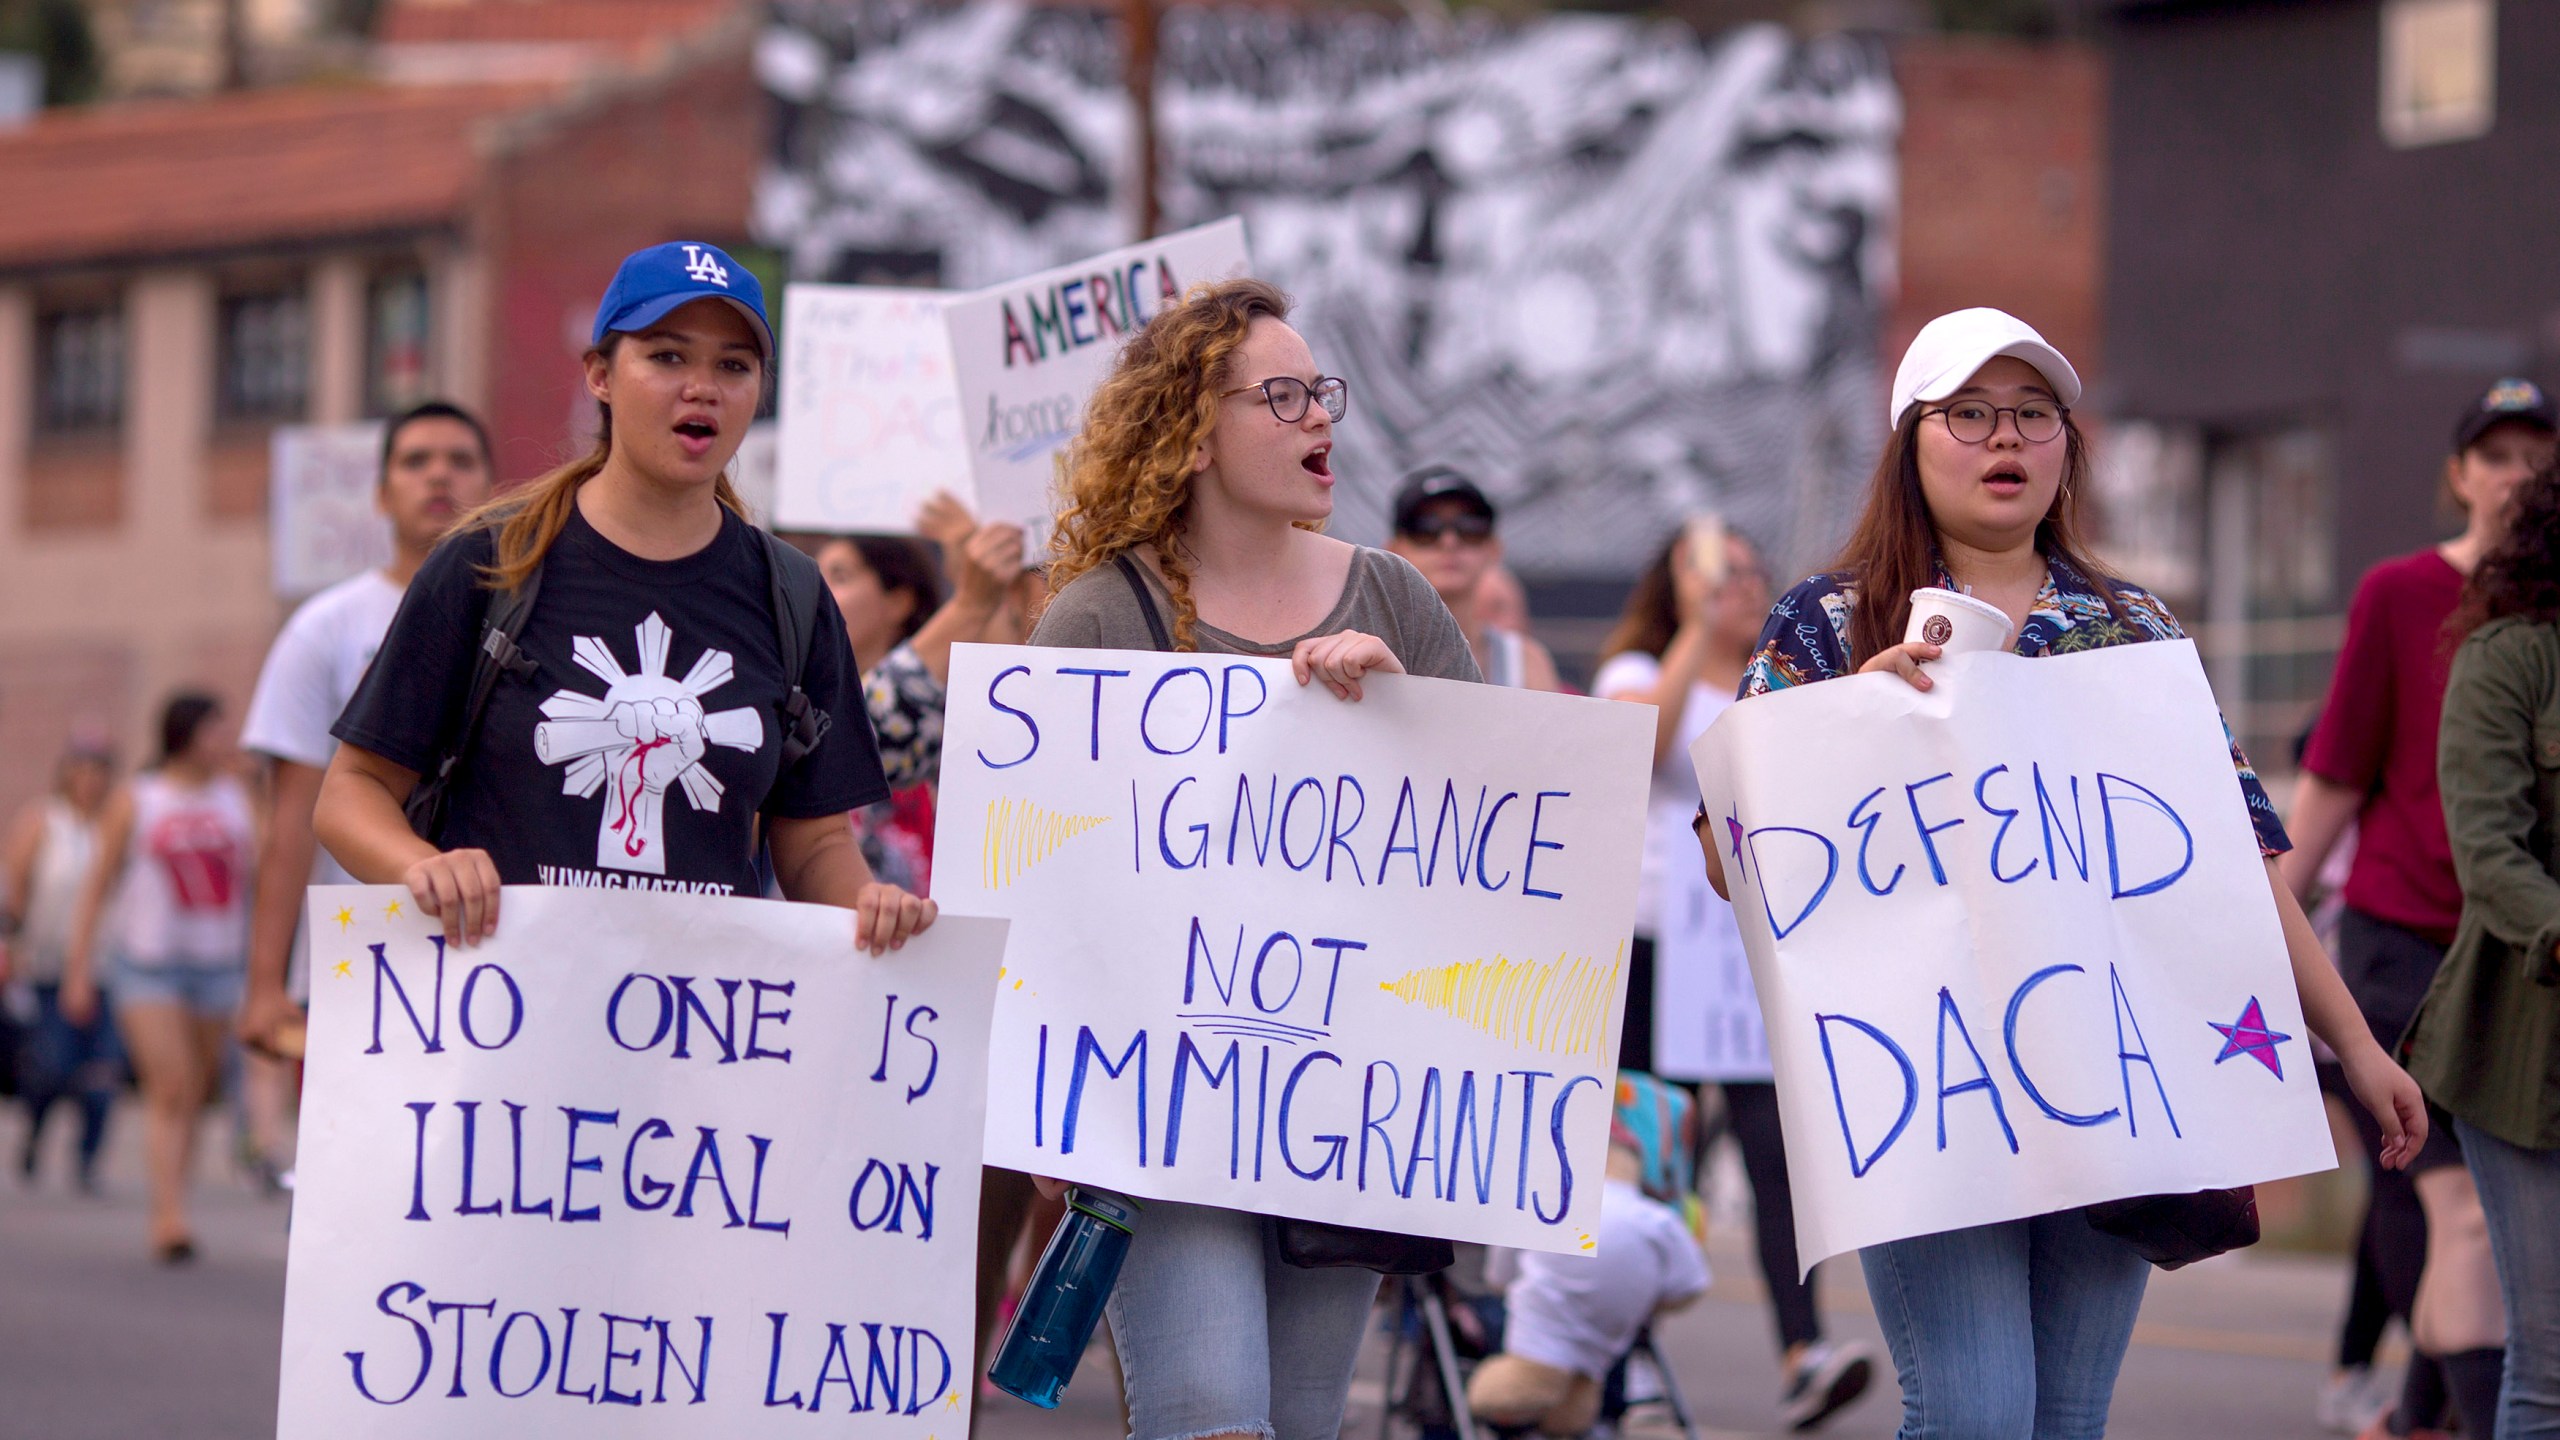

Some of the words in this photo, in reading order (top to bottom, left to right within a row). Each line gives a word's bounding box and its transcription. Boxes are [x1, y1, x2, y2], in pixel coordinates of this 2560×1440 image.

[682, 245, 728, 289] LA
[978, 665, 1266, 768] STOP
[1133, 773, 1570, 899] IGNORANCE
[1748, 762, 2193, 940] DEFEND
[366, 936, 523, 1054] NO
[607, 974, 795, 1064] ONE
[871, 995, 938, 1104] IS
[1184, 916, 1367, 1026] NOT
[1035, 1024, 1602, 1226] IMMIGRANTS
[1815, 962, 2181, 1178] DACA
[406, 1100, 790, 1236] ILLEGAL
[849, 1158, 940, 1242] ON
[345, 1281, 713, 1406] STOLEN
[764, 1312, 951, 1416] LAND
